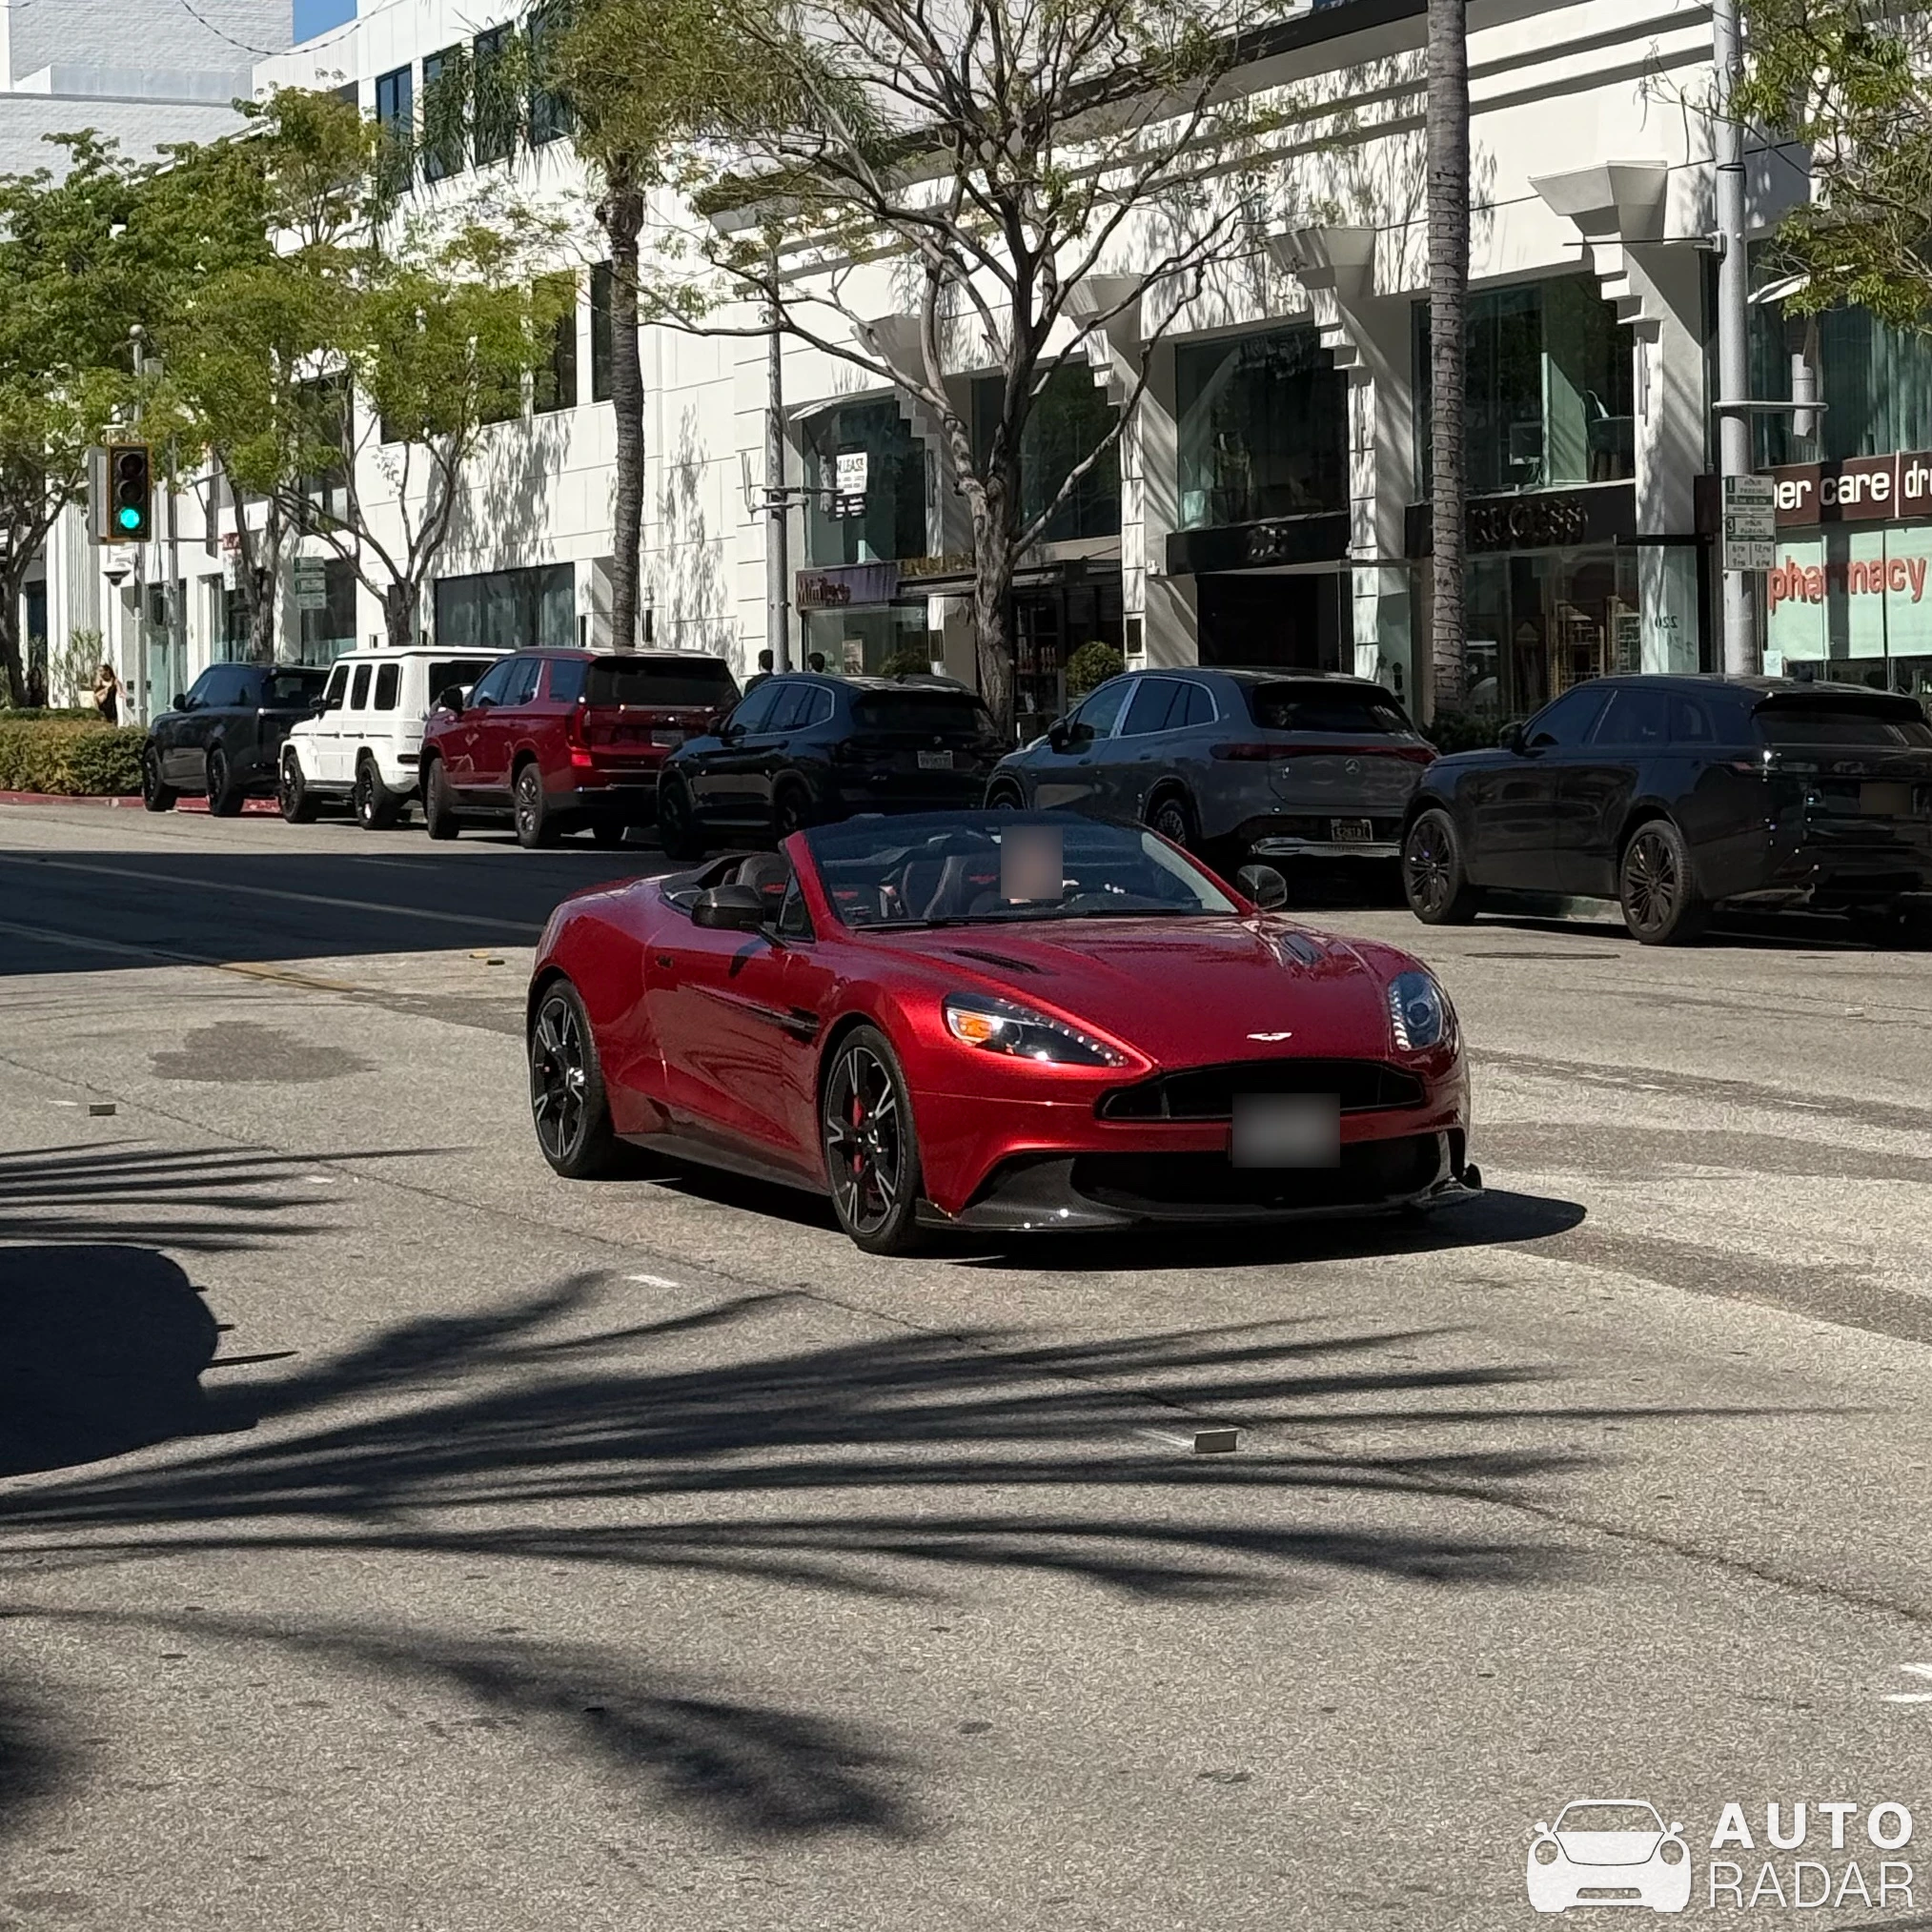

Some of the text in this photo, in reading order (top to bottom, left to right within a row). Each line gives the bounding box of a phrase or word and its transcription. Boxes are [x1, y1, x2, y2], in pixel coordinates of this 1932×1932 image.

[1774, 479, 1812, 510] er
[1820, 472, 1890, 506] care
[1768, 555, 1926, 617] pharmacy
